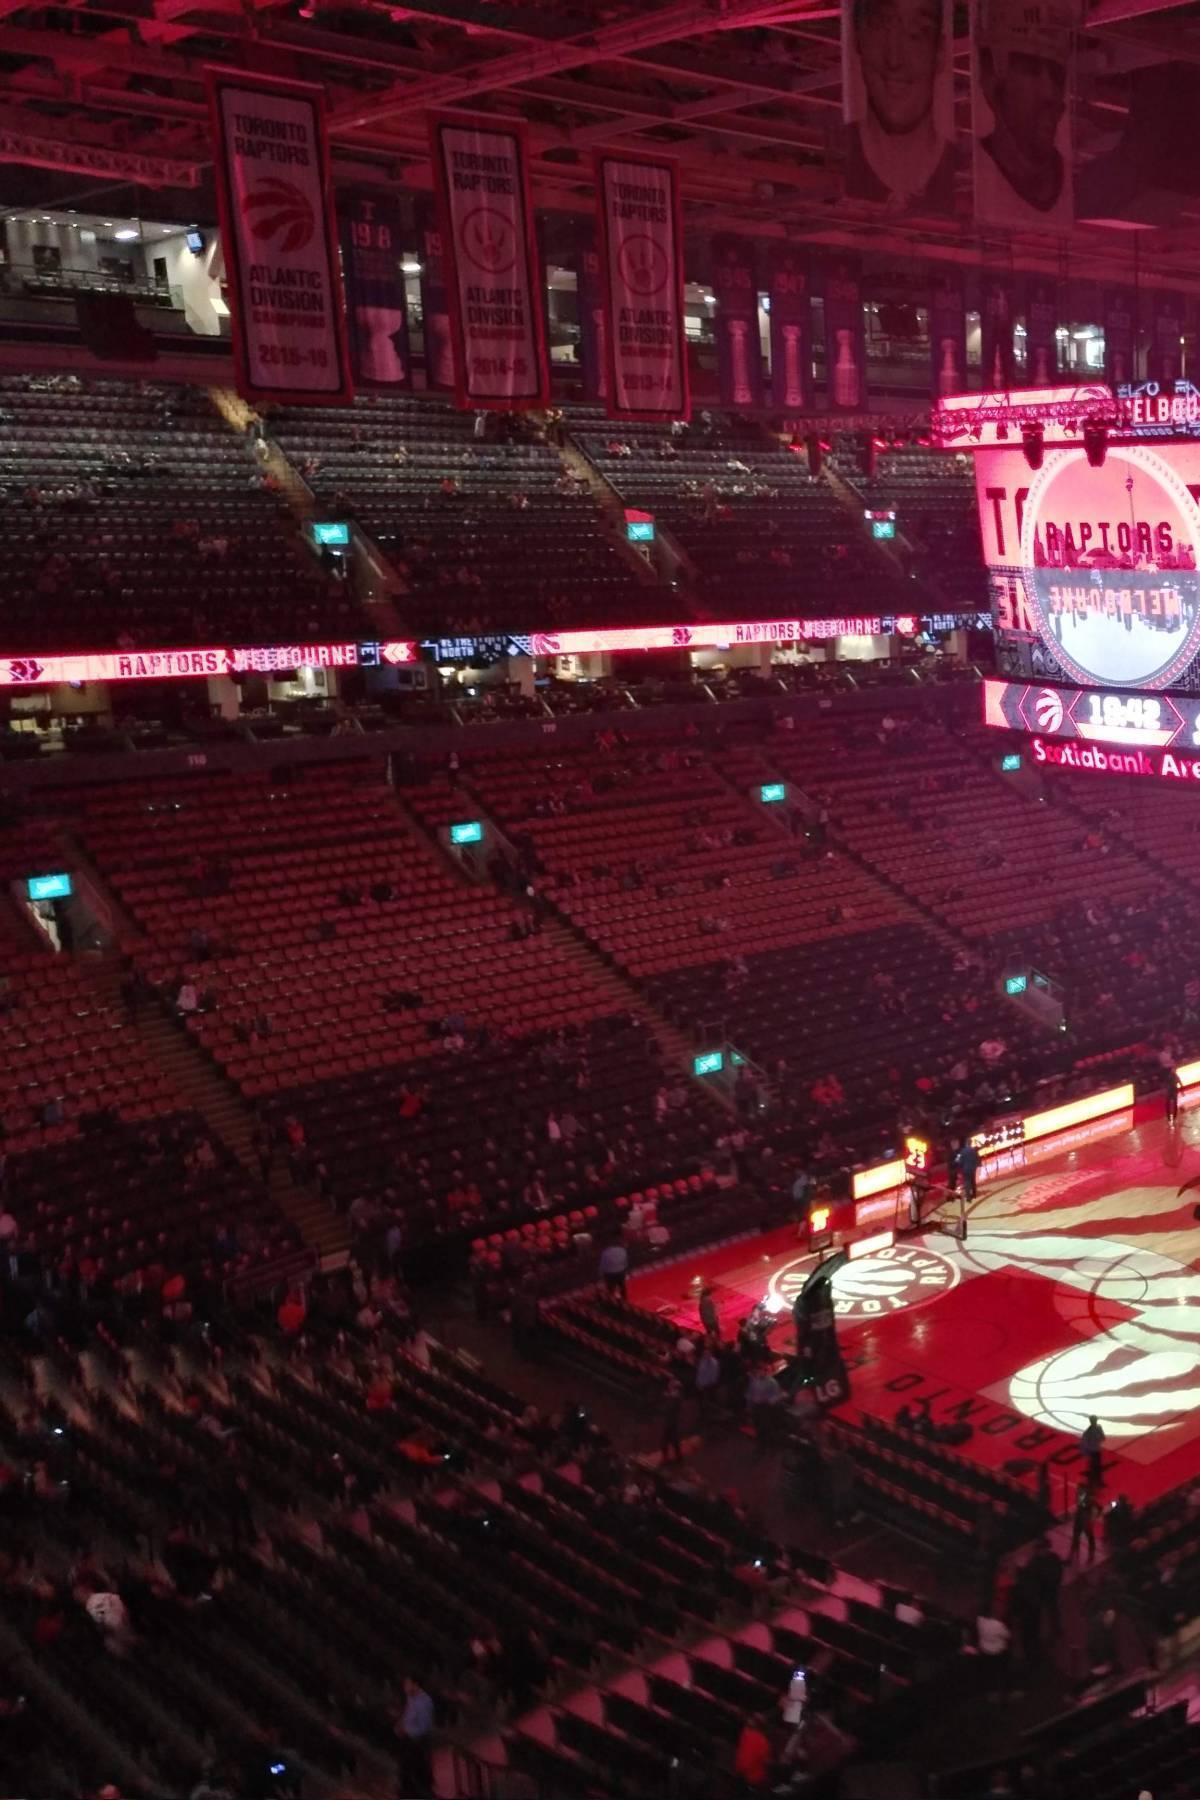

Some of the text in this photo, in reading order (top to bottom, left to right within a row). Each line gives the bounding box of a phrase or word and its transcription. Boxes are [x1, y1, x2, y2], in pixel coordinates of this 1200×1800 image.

[233, 114, 308, 142] TORONTO
[234, 136, 310, 167] RAPTORS
[452, 152, 512, 175] TORONTO
[452, 173, 514, 194] RAPTORS
[612, 182, 666, 203] TORONTO
[612, 200, 667, 224] RAPTORS
[351, 221, 392, 249] 198
[424, 231, 443, 256] 19
[250, 265, 321, 290] ATLANTIC
[251, 287, 323, 312] DIVISION
[467, 307, 524, 326] DIVISION
[619, 308, 672, 326] ATLANTIC
[619, 327, 673, 345] DIVISION
[1045, 522, 1173, 553] RAPTORS
[736, 623, 795, 642] RAPTORS
[118, 644, 357, 677] RAPTORS MELBOURNE
[441, 647, 474, 659] NORTH
[1032, 739, 1155, 775] Scotiabank
